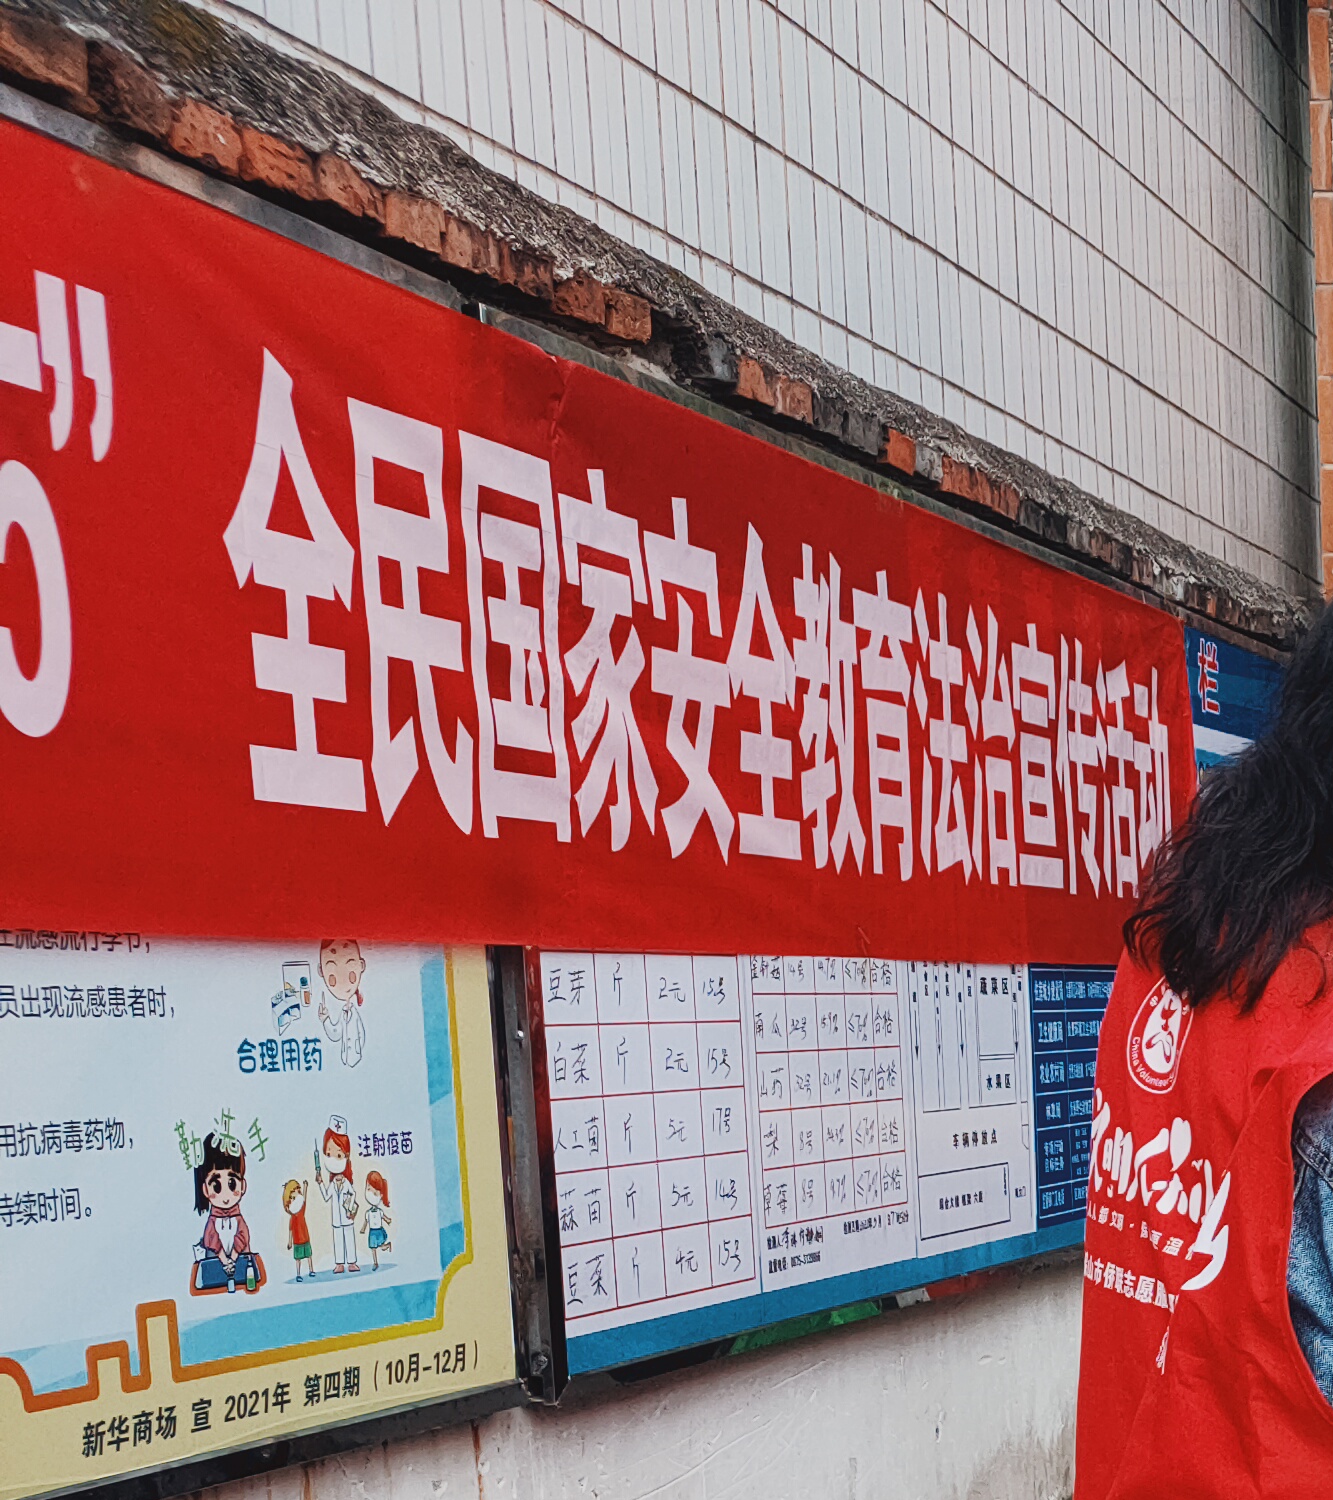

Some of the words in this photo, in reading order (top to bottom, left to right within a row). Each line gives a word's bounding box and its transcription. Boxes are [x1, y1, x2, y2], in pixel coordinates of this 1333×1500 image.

[221, 346, 1176, 900] 全民国家安全教育法治宣传活动
[1197, 637, 1220, 715] 栏
[548, 968, 586, 1005] 豆芽
[659, 976, 686, 1003] 2元
[702, 977, 726, 1005] 15号
[870, 958, 893, 987] 合格
[874, 1004, 894, 1038] 合格
[237, 1037, 323, 1074] 合理用药
[553, 1042, 589, 1084] 白菜
[666, 1047, 688, 1073] 2元
[707, 1048, 731, 1079] 15号
[877, 1059, 897, 1091] 合格
[174, 1108, 270, 1170] 勤洗手
[666, 1118, 687, 1142] 5元
[713, 1107, 731, 1136] 17号
[881, 1114, 899, 1145] 合格
[358, 1131, 414, 1158] 注射疫苗
[882, 1162, 903, 1191] 合格
[560, 1188, 602, 1232] 蒜苗
[672, 1182, 694, 1207] 5元
[718, 1239, 741, 1272] 15号
[82, 1415, 178, 1459] 新华商场
[191, 1399, 212, 1433] 宣
[224, 1381, 292, 1424] 2021年
[303, 1365, 361, 1408] 第四期
